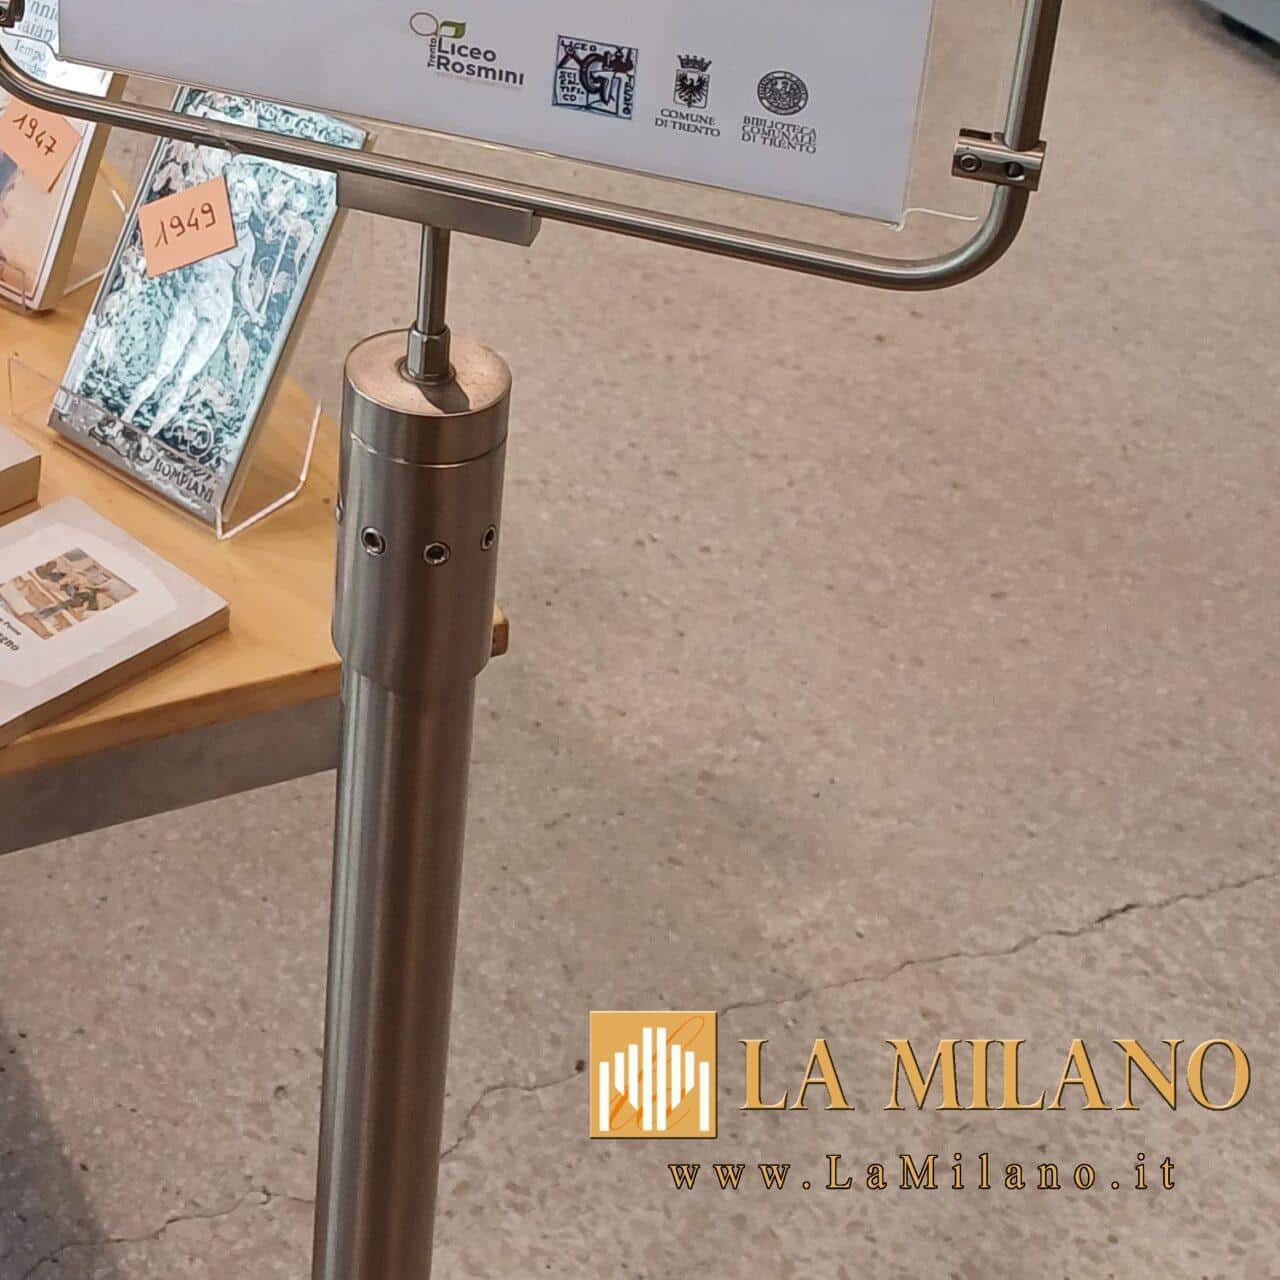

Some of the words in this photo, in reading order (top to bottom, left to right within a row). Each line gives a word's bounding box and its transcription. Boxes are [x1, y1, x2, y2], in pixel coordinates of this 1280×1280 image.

[427, 37, 438, 68] Trento
[437, 38, 497, 62] Liceo
[436, 54, 525, 86] Rosmini
[654, 118, 669, 129] DI
[671, 120, 721, 138] TRENTO
[660, 107, 715, 126] COMUNE
[743, 115, 817, 137] BIBLIOTECA
[13, 114, 58, 156] 1947
[740, 133, 756, 144] DI
[760, 136, 817, 155] TRENTO
[741, 124, 817, 145] COMUNALE
[155, 202, 217, 248] 1949
[152, 458, 215, 504] BOMPIANI
